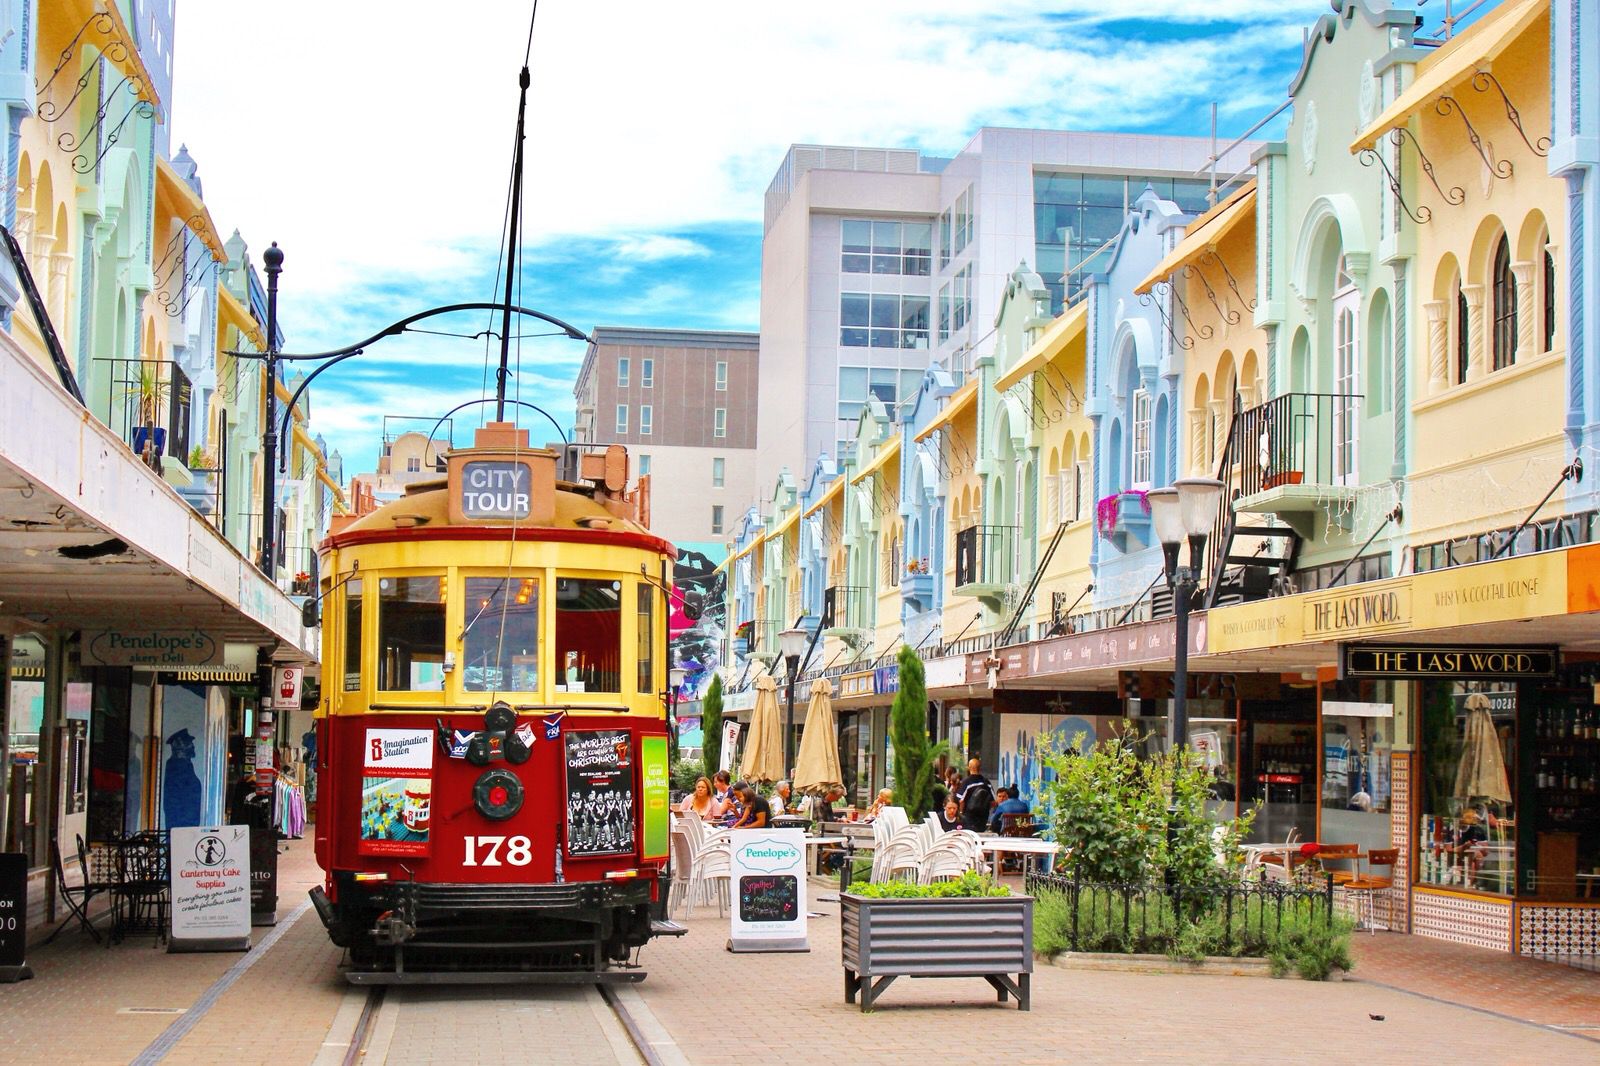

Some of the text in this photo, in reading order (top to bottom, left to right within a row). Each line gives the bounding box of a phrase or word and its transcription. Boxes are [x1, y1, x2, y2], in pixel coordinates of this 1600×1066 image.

[470, 469, 523, 488] CITY
[463, 492, 529, 512] TOUR
[1507, 577, 1539, 599] LOUNGE
[1314, 600, 1332, 631] THE
[1335, 596, 1360, 628] LAST
[109, 632, 204, 654] Penelope's
[161, 653, 184, 663] Deli
[1372, 652, 1535, 672] THE LAST WORD.
[546, 725, 560, 736] FRA
[383, 735, 428, 749] Imagination
[568, 734, 629, 751] THE WORLD'S BEST
[383, 747, 410, 758] Station
[577, 750, 588, 758] ARE
[588, 747, 608, 756] COMING
[568, 753, 619, 769] CHRISTCHURCH
[462, 835, 533, 866] 178
[746, 848, 796, 860] Penelope's
[180, 868, 241, 878] Canterbury Cake
[195, 880, 225, 890] Supplies
[177, 892, 210, 904] Everything
[223, 887, 238, 895] need
[181, 903, 199, 912] create
[199, 899, 224, 911] fabulous
